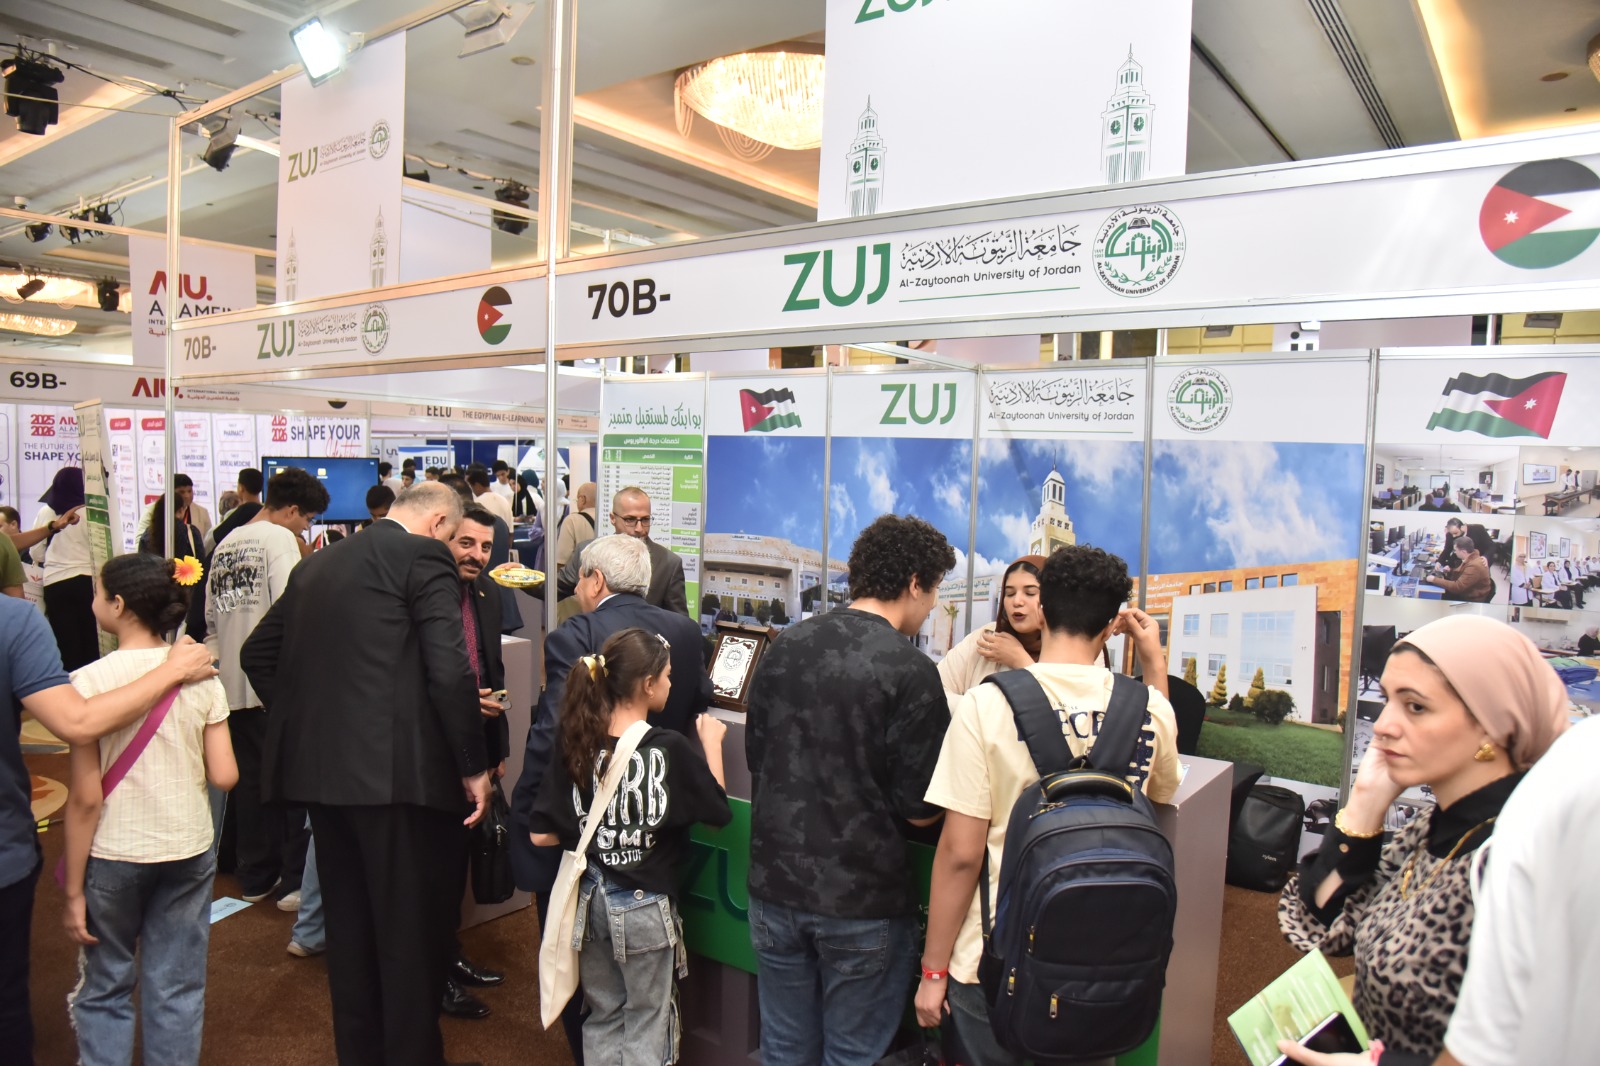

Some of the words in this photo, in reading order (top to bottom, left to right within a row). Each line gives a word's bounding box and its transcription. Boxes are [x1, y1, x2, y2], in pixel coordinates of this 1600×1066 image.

[288, 146, 318, 183] ZUJ
[782, 242, 890, 312] ZUJ
[900, 274, 970, 288] Al-Zaytoonah
[974, 269, 1025, 281] University
[1029, 267, 1040, 278] of
[1043, 265, 1081, 276] Jordan
[1126, 283, 1159, 294] UNIVERSITY
[1166, 255, 1180, 280] JORDAN
[588, 278, 671, 320] 70B-
[184, 336, 216, 360] 70B-
[257, 320, 294, 359] ZUJ
[10, 371, 67, 389] 69B-
[427, 405, 452, 417] EELU
[879, 382, 957, 425] ZUJ
[31, 414, 55, 425] 2025
[474, 412, 501, 420] EGYPTIAN
[502, 414, 534, 423] E-LEARNING
[608, 408, 632, 429] متميز
[635, 406, 668, 429] لمستقبل
[671, 402, 701, 429] بوابتك
[988, 412, 1045, 421] Al-Zaytoonah
[1048, 412, 1089, 421] University
[1092, 412, 1101, 421] of
[1103, 412, 1134, 420] Jordan
[31, 426, 55, 436] 2026
[272, 428, 287, 442] 2026
[291, 426, 325, 440] SHAPE
[328, 425, 360, 440] YOUR
[24, 452, 64, 460] SHAPE
[426, 456, 447, 465] EDU
